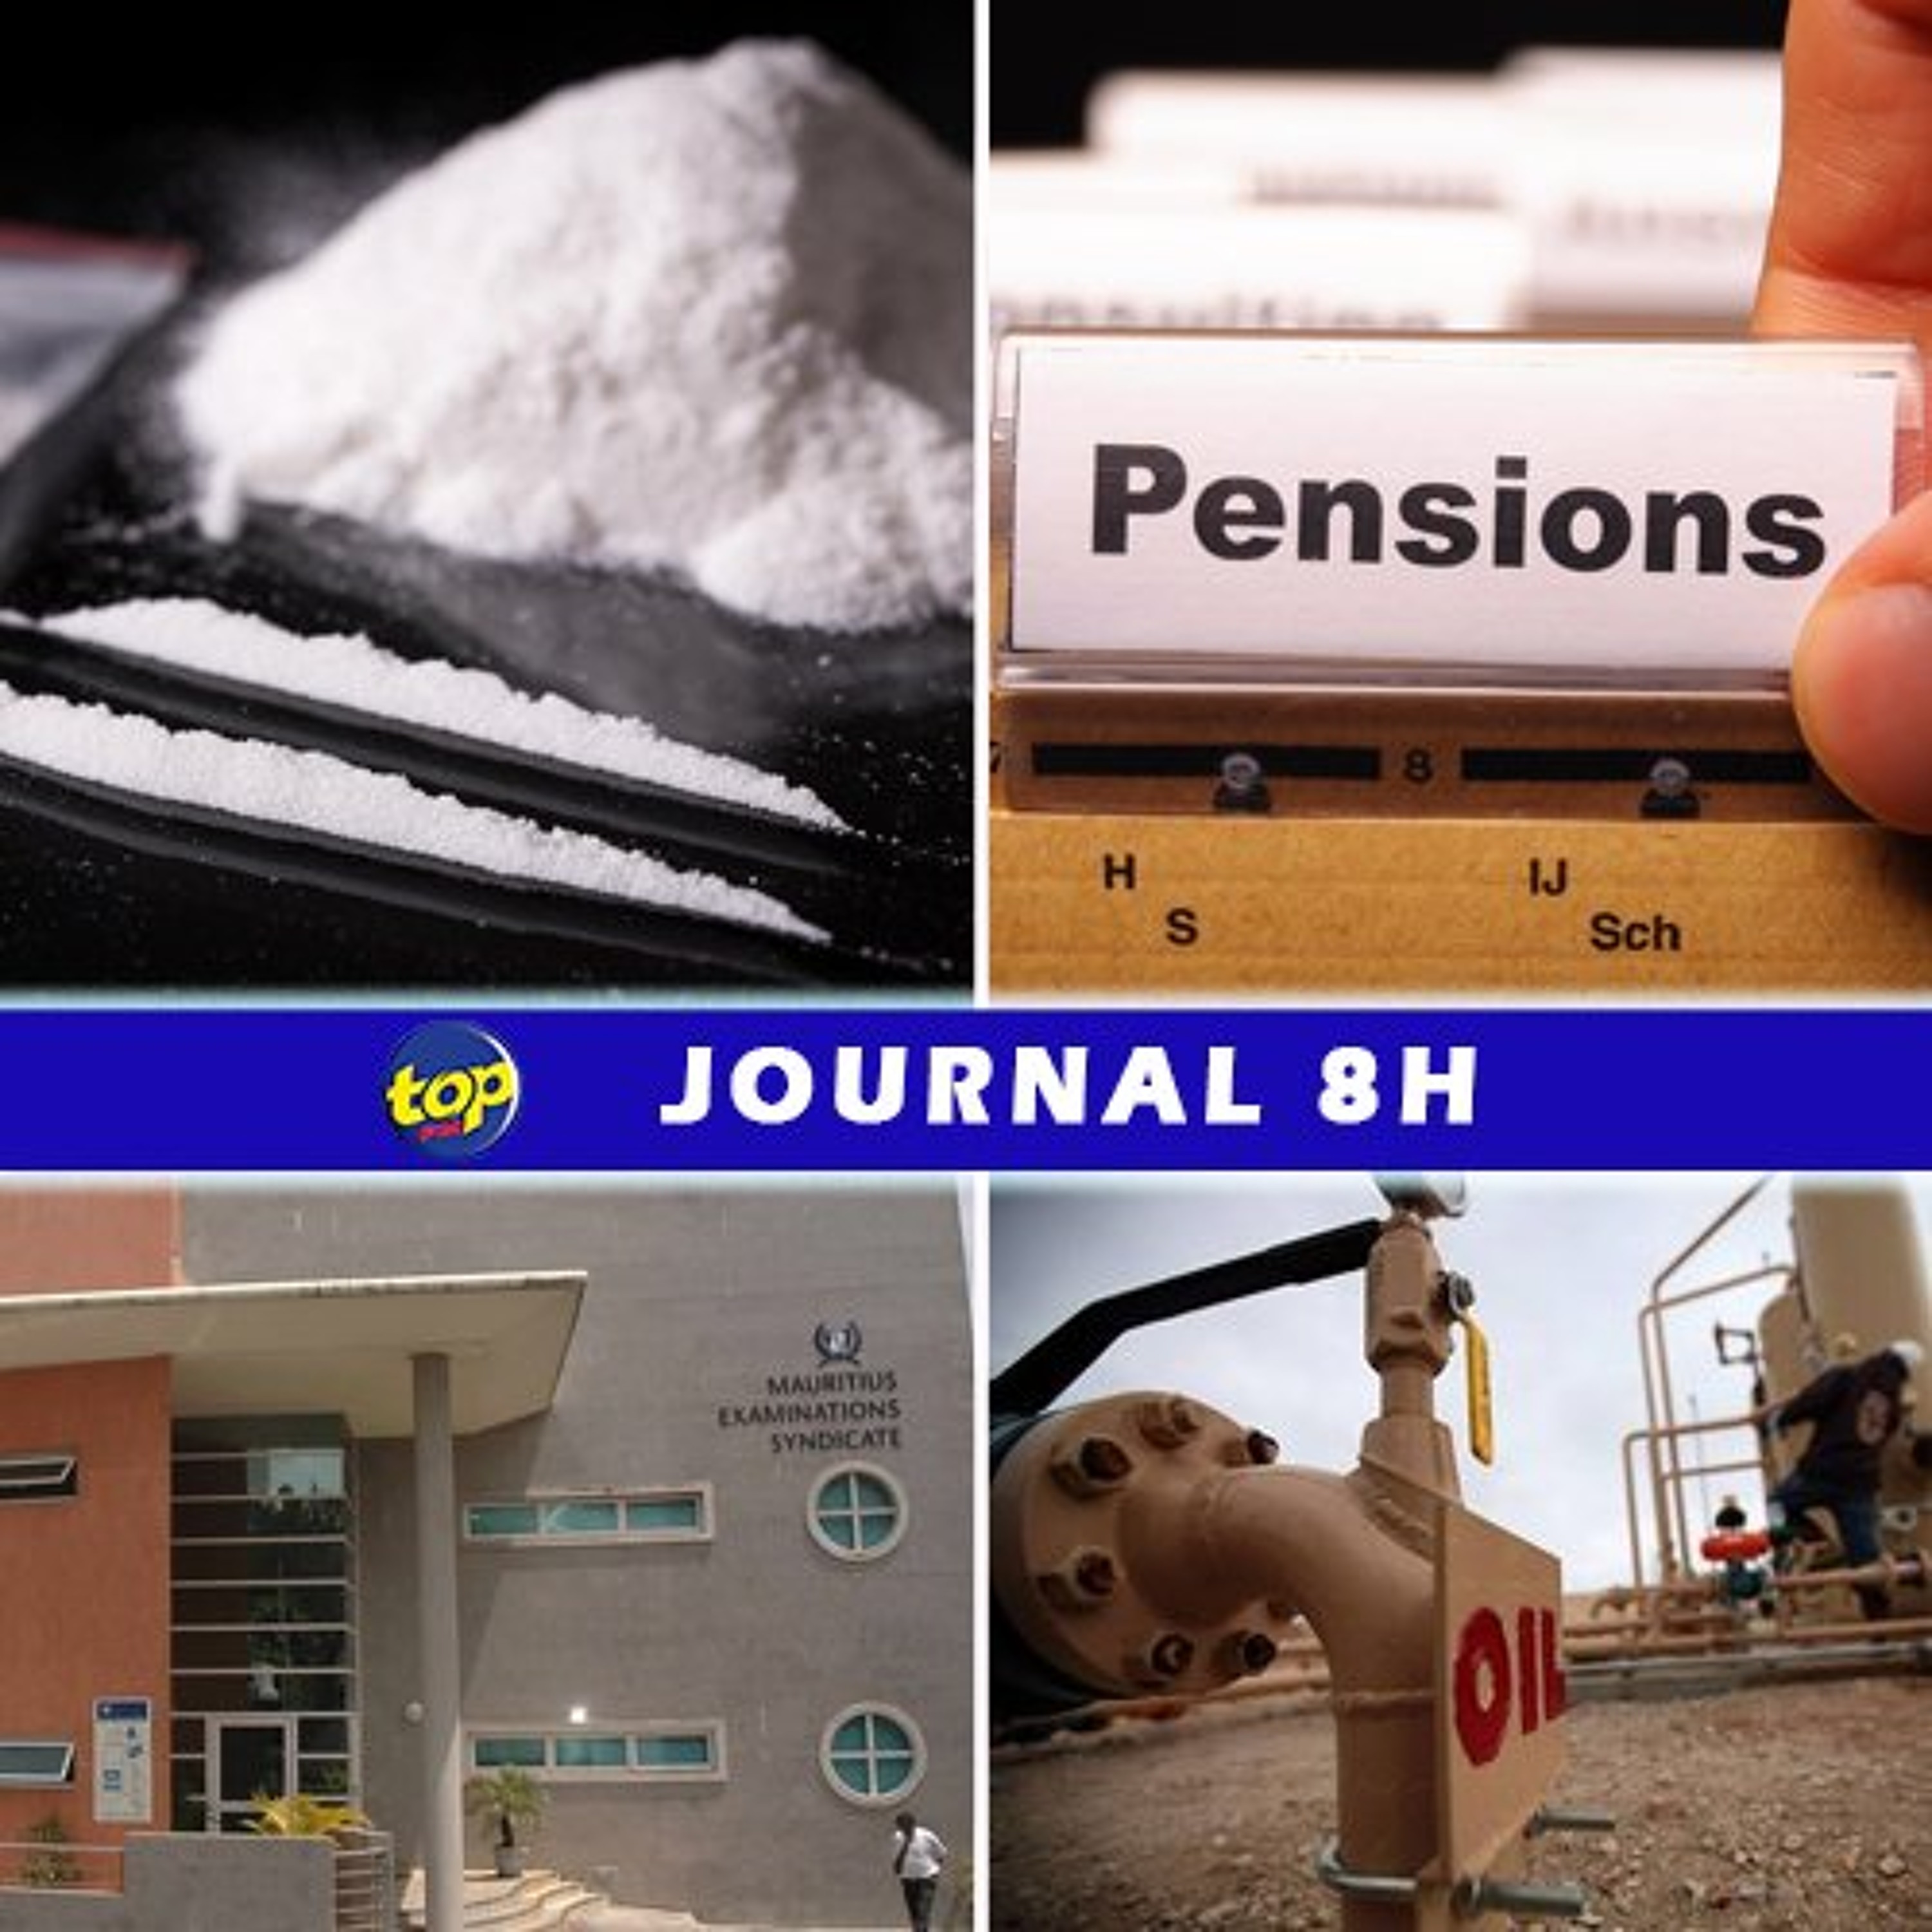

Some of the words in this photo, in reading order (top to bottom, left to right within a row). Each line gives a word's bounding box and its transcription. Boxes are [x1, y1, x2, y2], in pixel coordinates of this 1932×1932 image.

[1093, 444, 1825, 578] Pensions
[1403, 749, 1434, 784] 8
[1103, 854, 1136, 891] H
[1529, 858, 1567, 897] IJ
[1166, 907, 1199, 947] S
[1589, 912, 1682, 952] Sch
[767, 1370, 898, 1396] MAURITIUS
[718, 1398, 901, 1428] EXAMINATIONS
[772, 1427, 901, 1454] SYNDICATE
[1453, 1606, 1566, 1767] OIL
